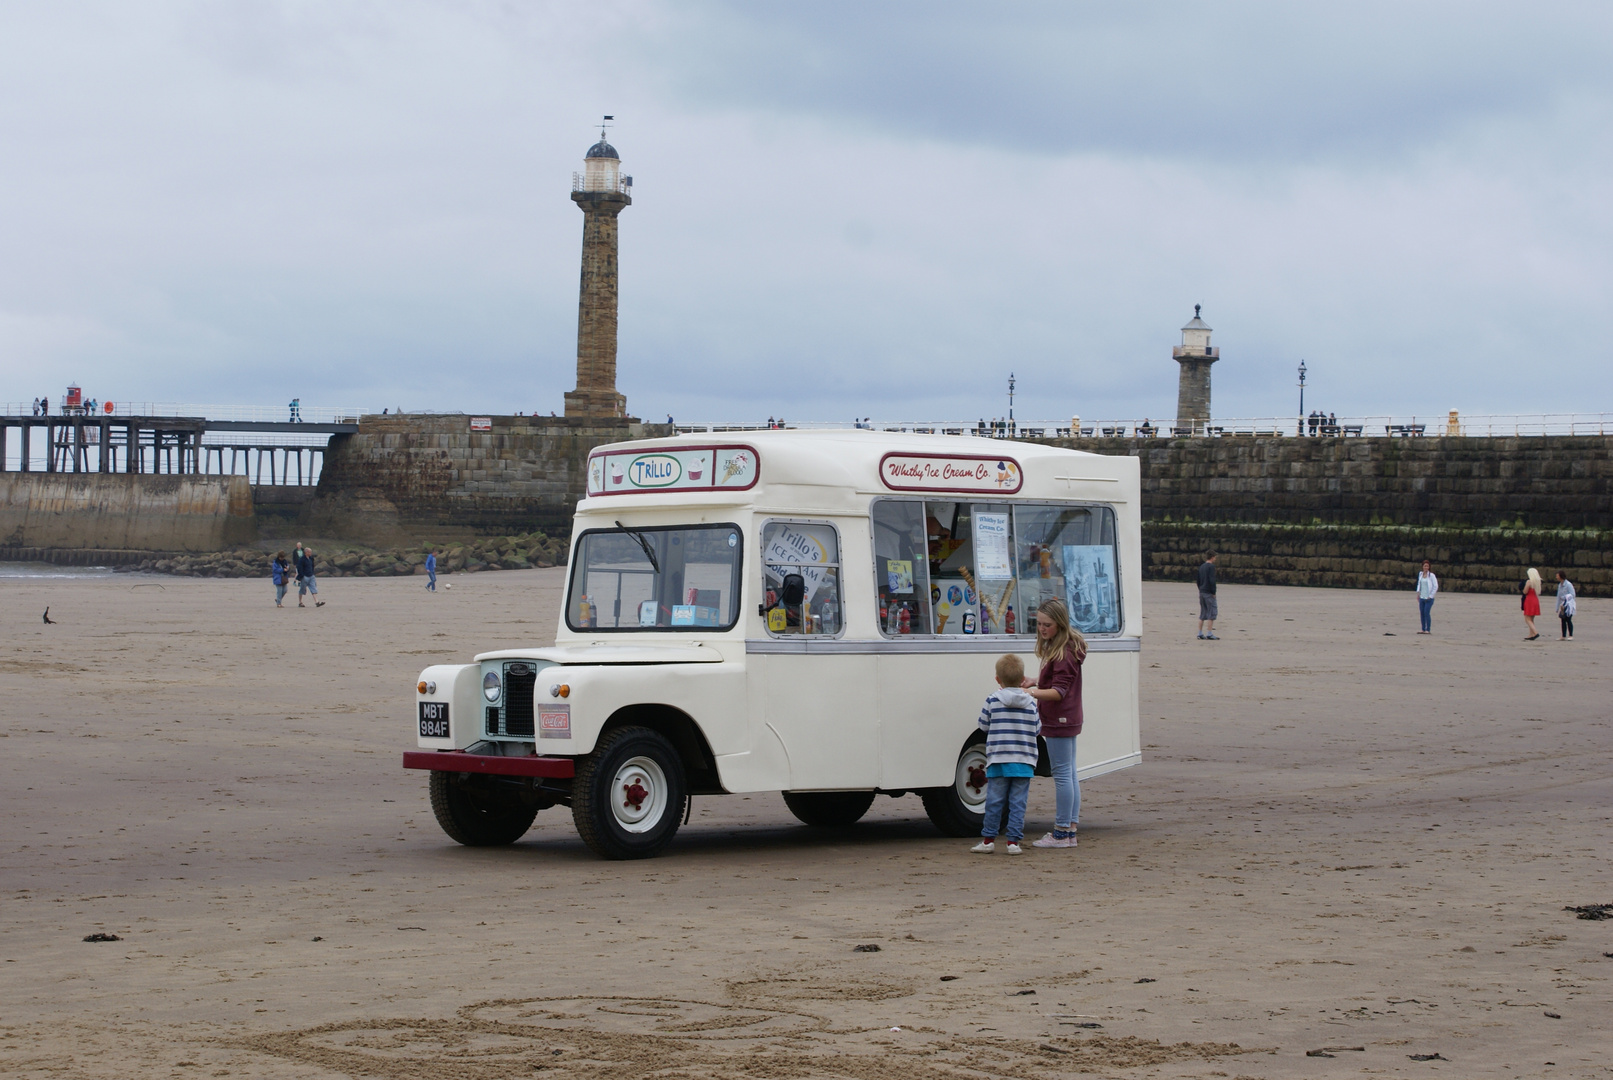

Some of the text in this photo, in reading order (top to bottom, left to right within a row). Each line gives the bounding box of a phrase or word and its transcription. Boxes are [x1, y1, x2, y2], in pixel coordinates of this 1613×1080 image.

[888, 463, 991, 481] Whitby Ice Cream Co.
[978, 516, 996, 525] Whitby
[978, 523, 996, 531] Cream
[771, 543, 788, 559] ICE
[781, 525, 819, 561] Trillo's
[423, 703, 444, 719] MBT
[420, 720, 448, 736] 984F
